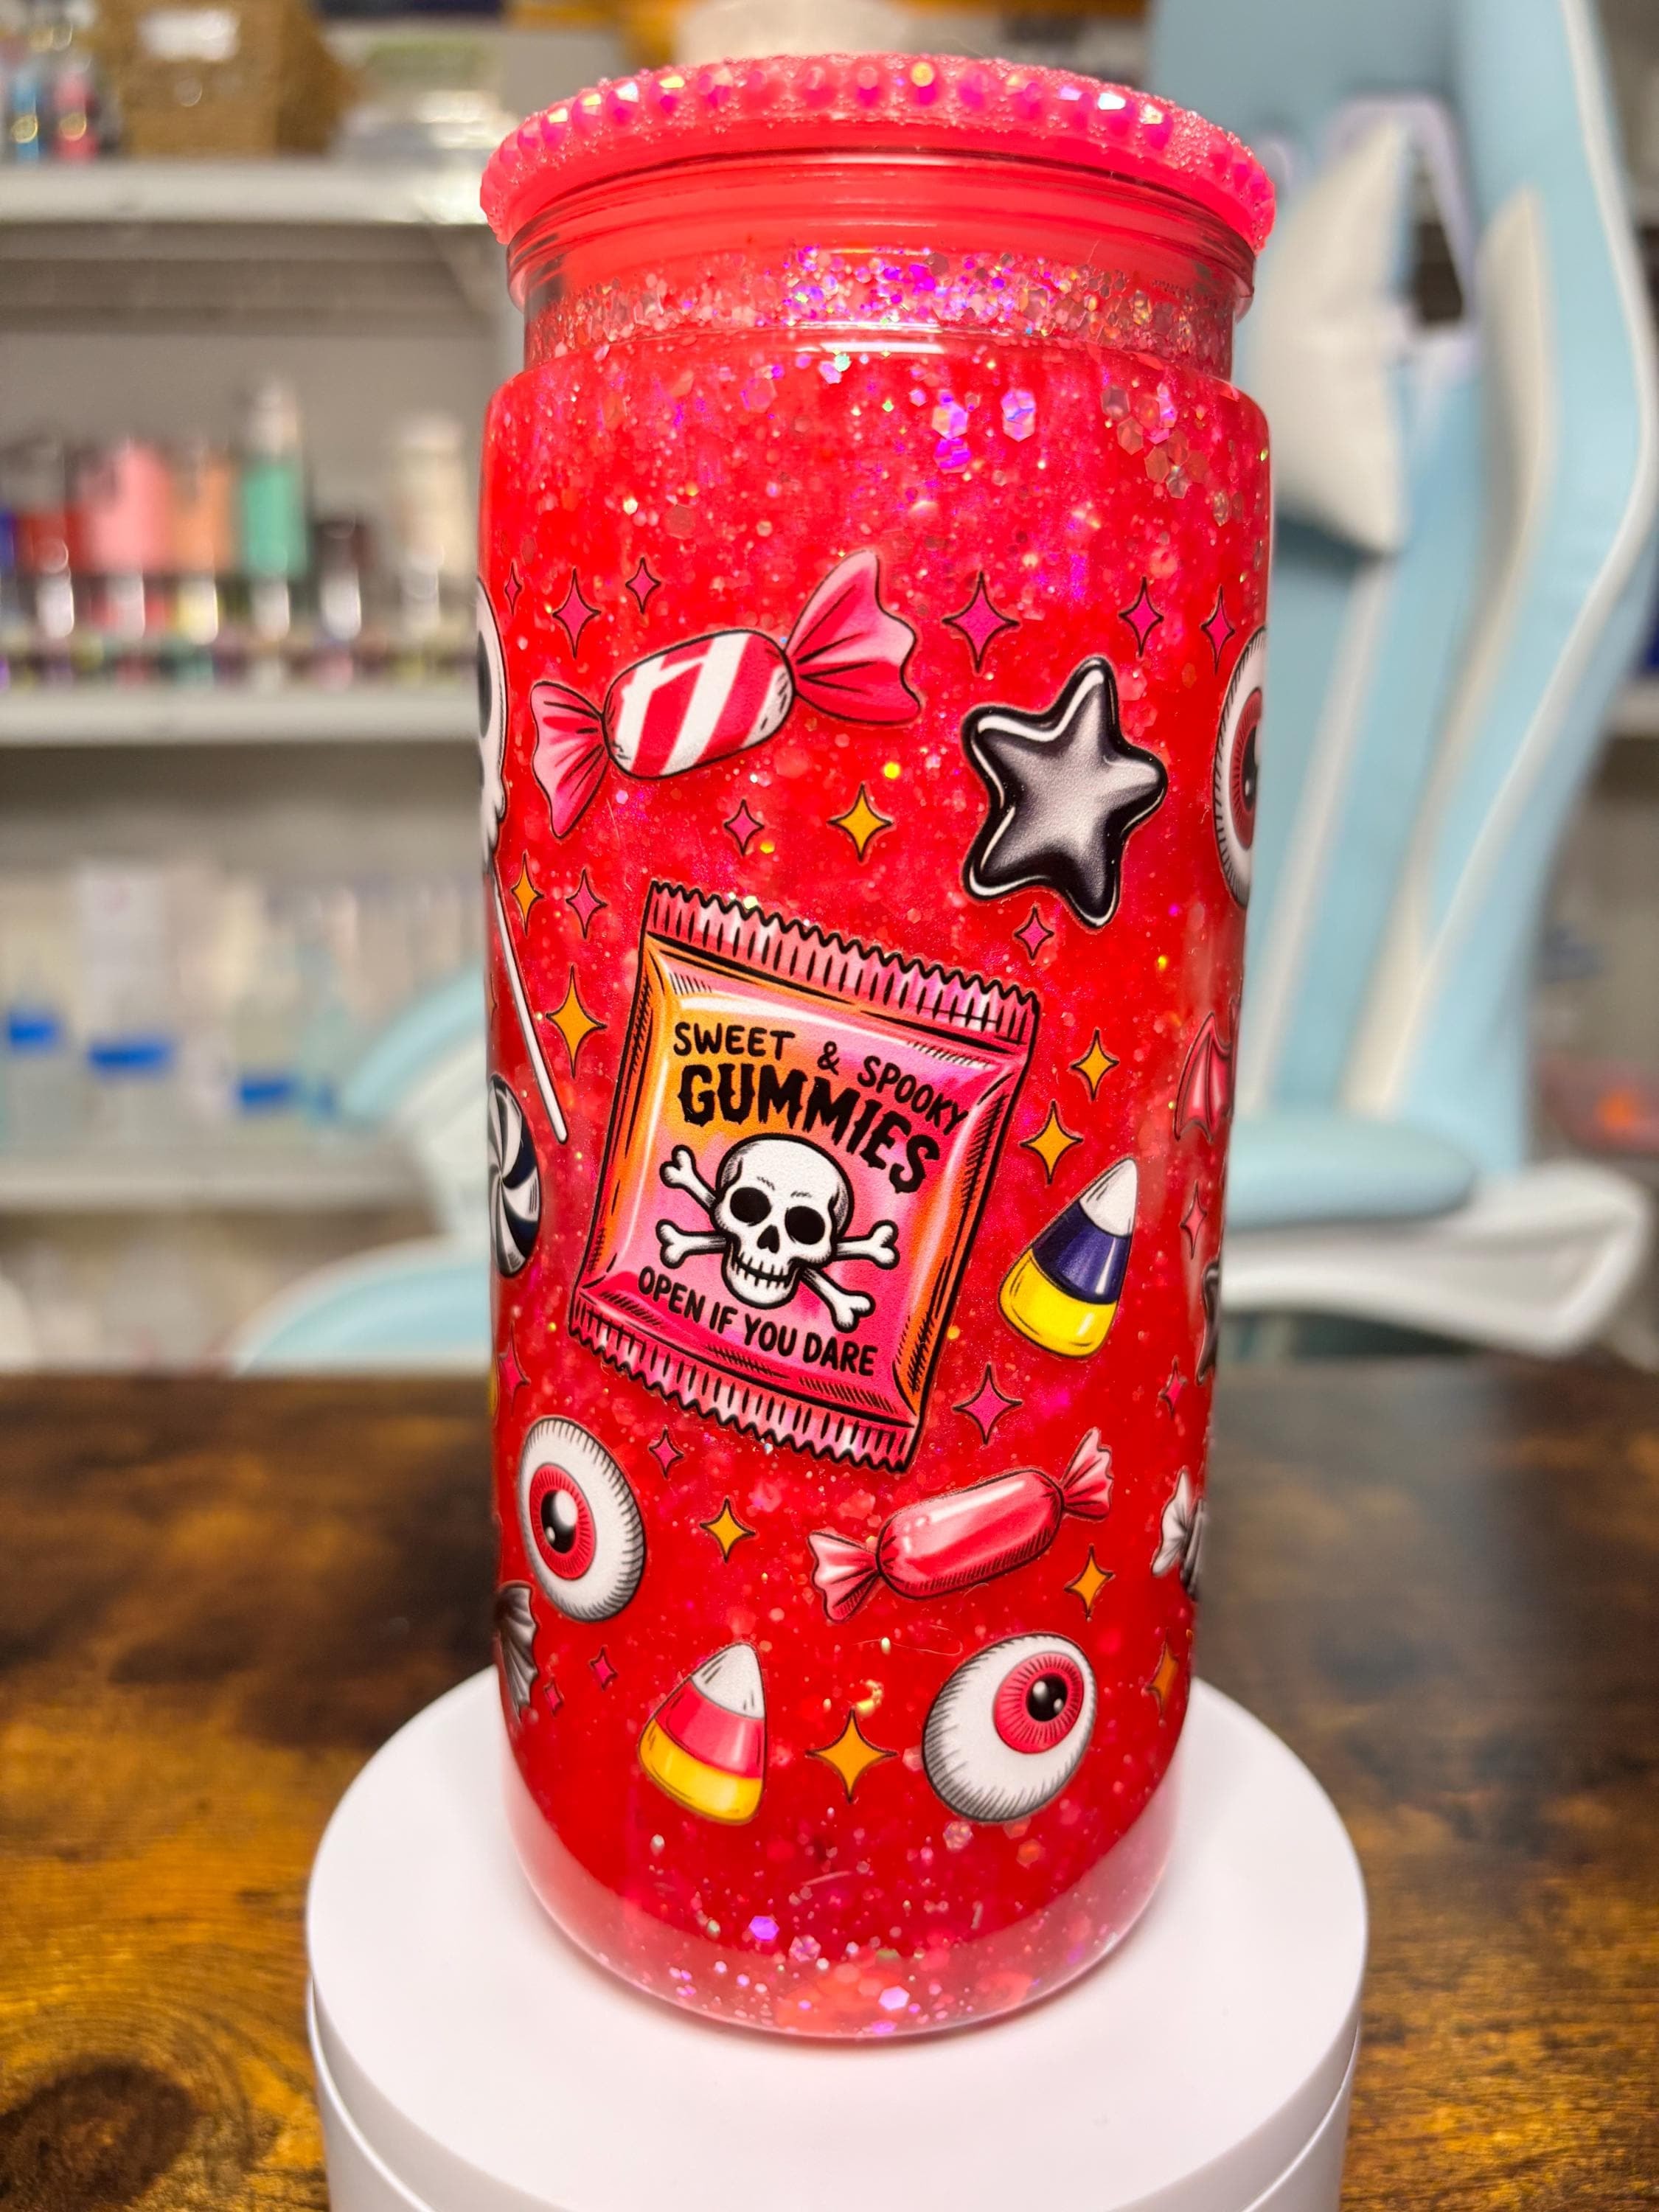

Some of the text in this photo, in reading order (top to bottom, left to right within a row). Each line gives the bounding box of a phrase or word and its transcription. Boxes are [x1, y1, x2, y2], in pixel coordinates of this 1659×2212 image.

[673, 1022, 969, 1135] SWEET & SPOOKY
[678, 1063, 940, 1194] GUMMIES
[637, 1266, 879, 1377] OPEN IF YOU DARE
